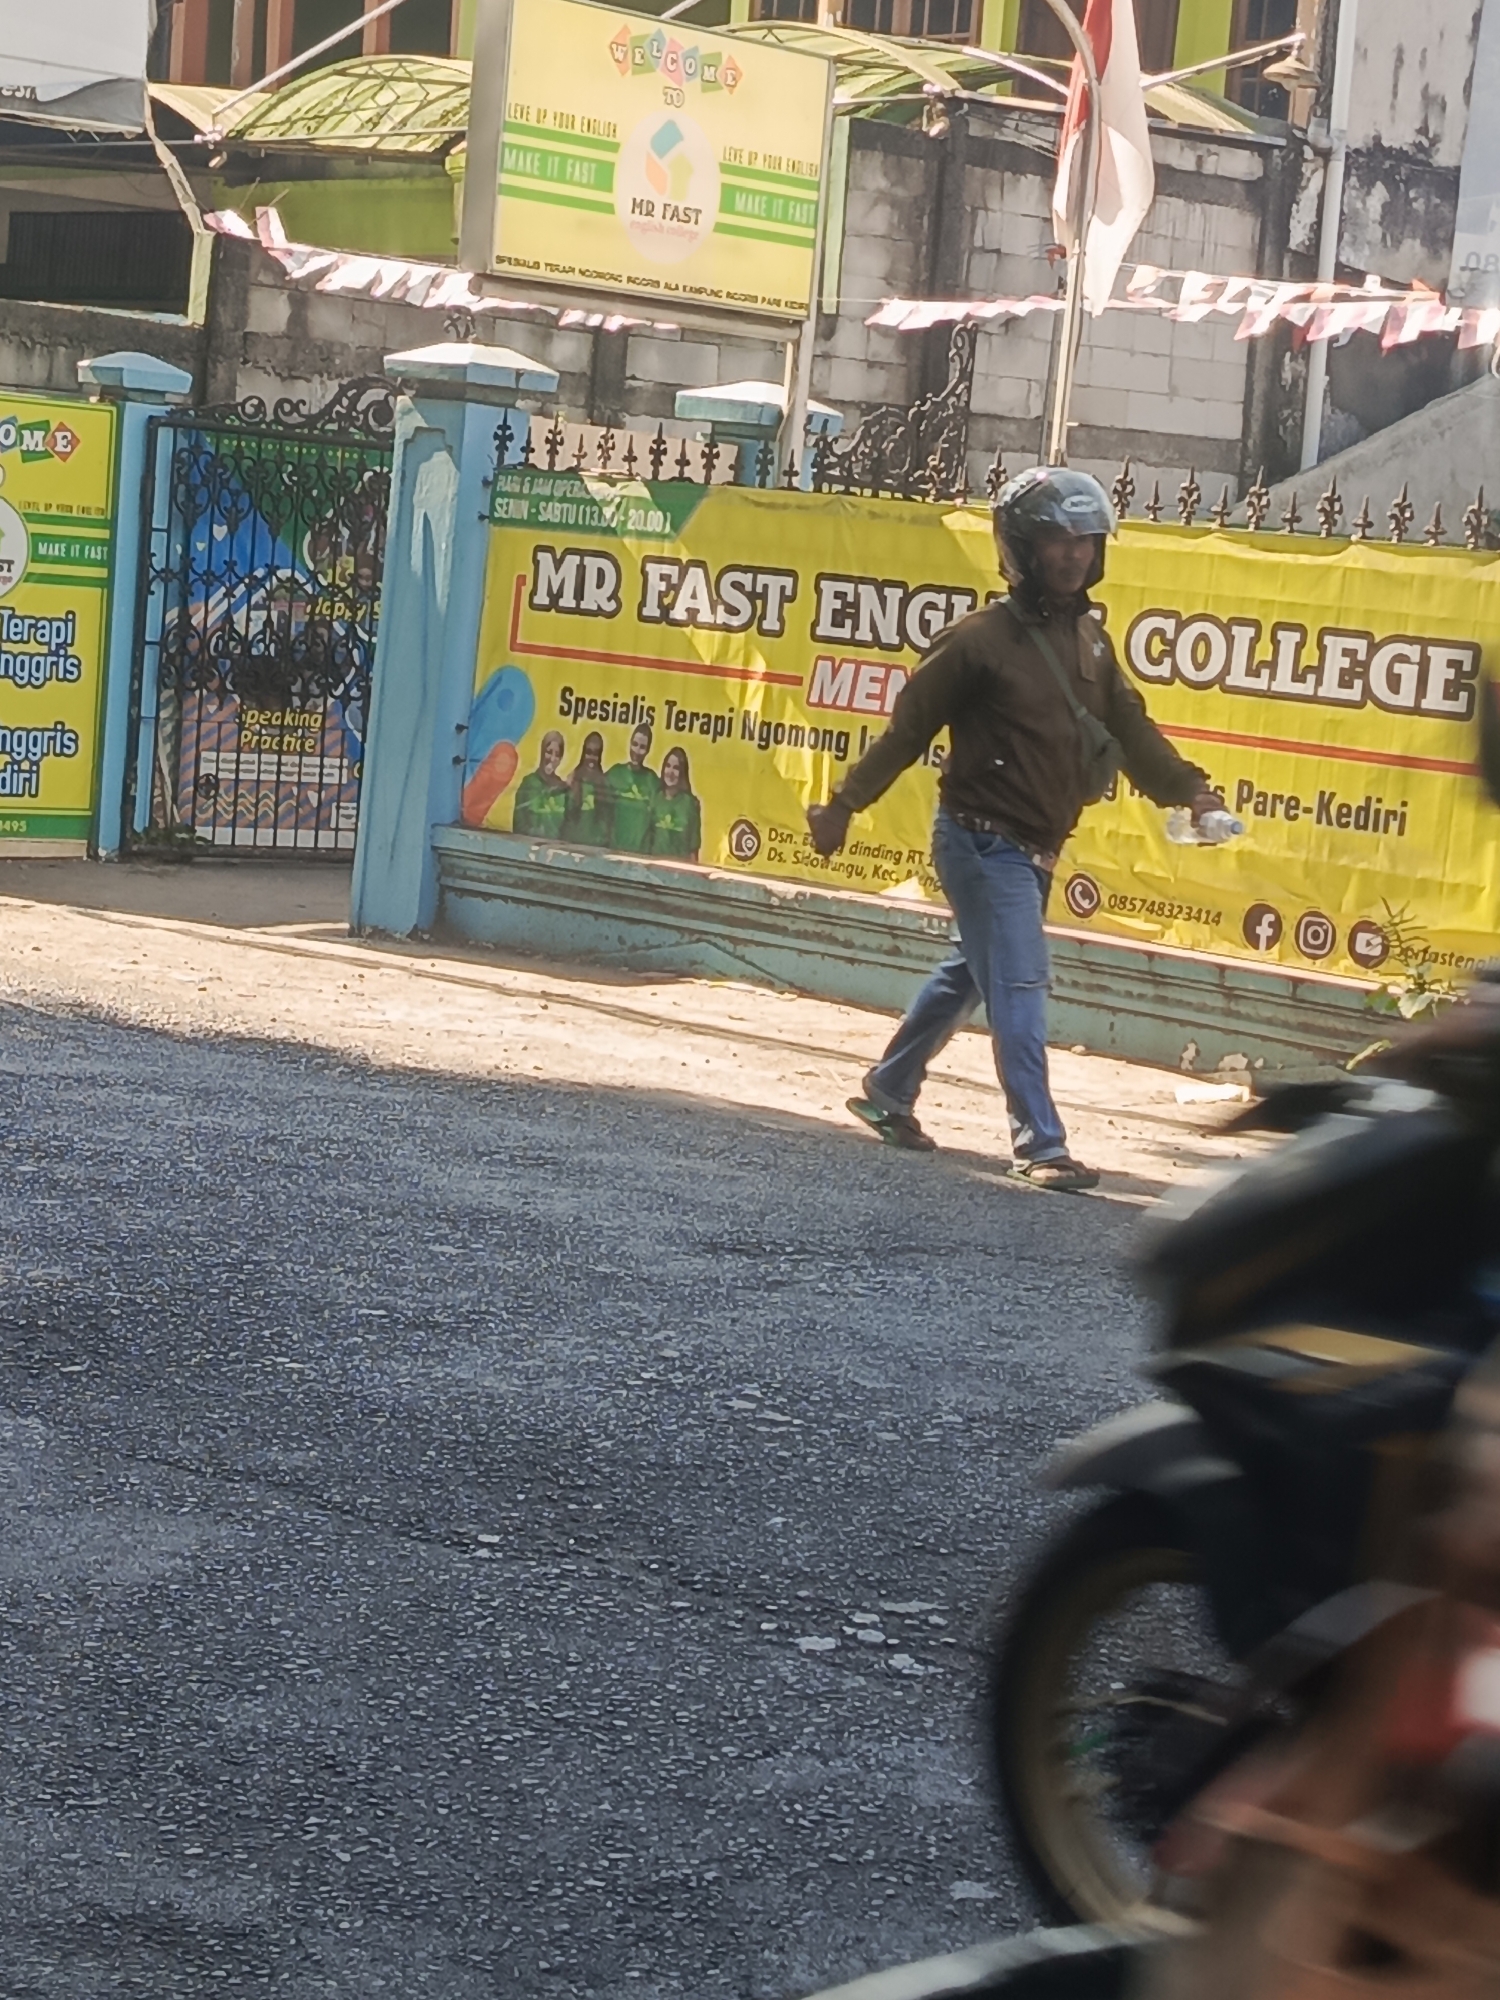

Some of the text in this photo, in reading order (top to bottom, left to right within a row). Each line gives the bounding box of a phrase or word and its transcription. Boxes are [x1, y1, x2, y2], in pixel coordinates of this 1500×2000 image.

[609, 39, 740, 88] WELCOME
[662, 86, 685, 108] TO
[503, 147, 598, 185] MAKE IT FAST
[631, 197, 702, 226] MR FAST
[735, 190, 816, 226] MAKE IT FAST
[538, 501, 577, 525] SABTU
[38, 542, 108, 561] MAKE IT FAST
[0, 609, 75, 652] Terapi
[533, 547, 619, 615] MR
[640, 557, 795, 635] FAST
[1126, 611, 1479, 719] COLLEGE
[241, 706, 323, 731] peaking
[559, 687, 655, 727] Spesialis
[665, 702, 734, 745] Terapi
[741, 713, 850, 761] Ngomong
[1236, 779, 1408, 837] Pare-Kediri
[849, 840, 904, 865] dinding
[1107, 894, 1223, 926] 085748323414
